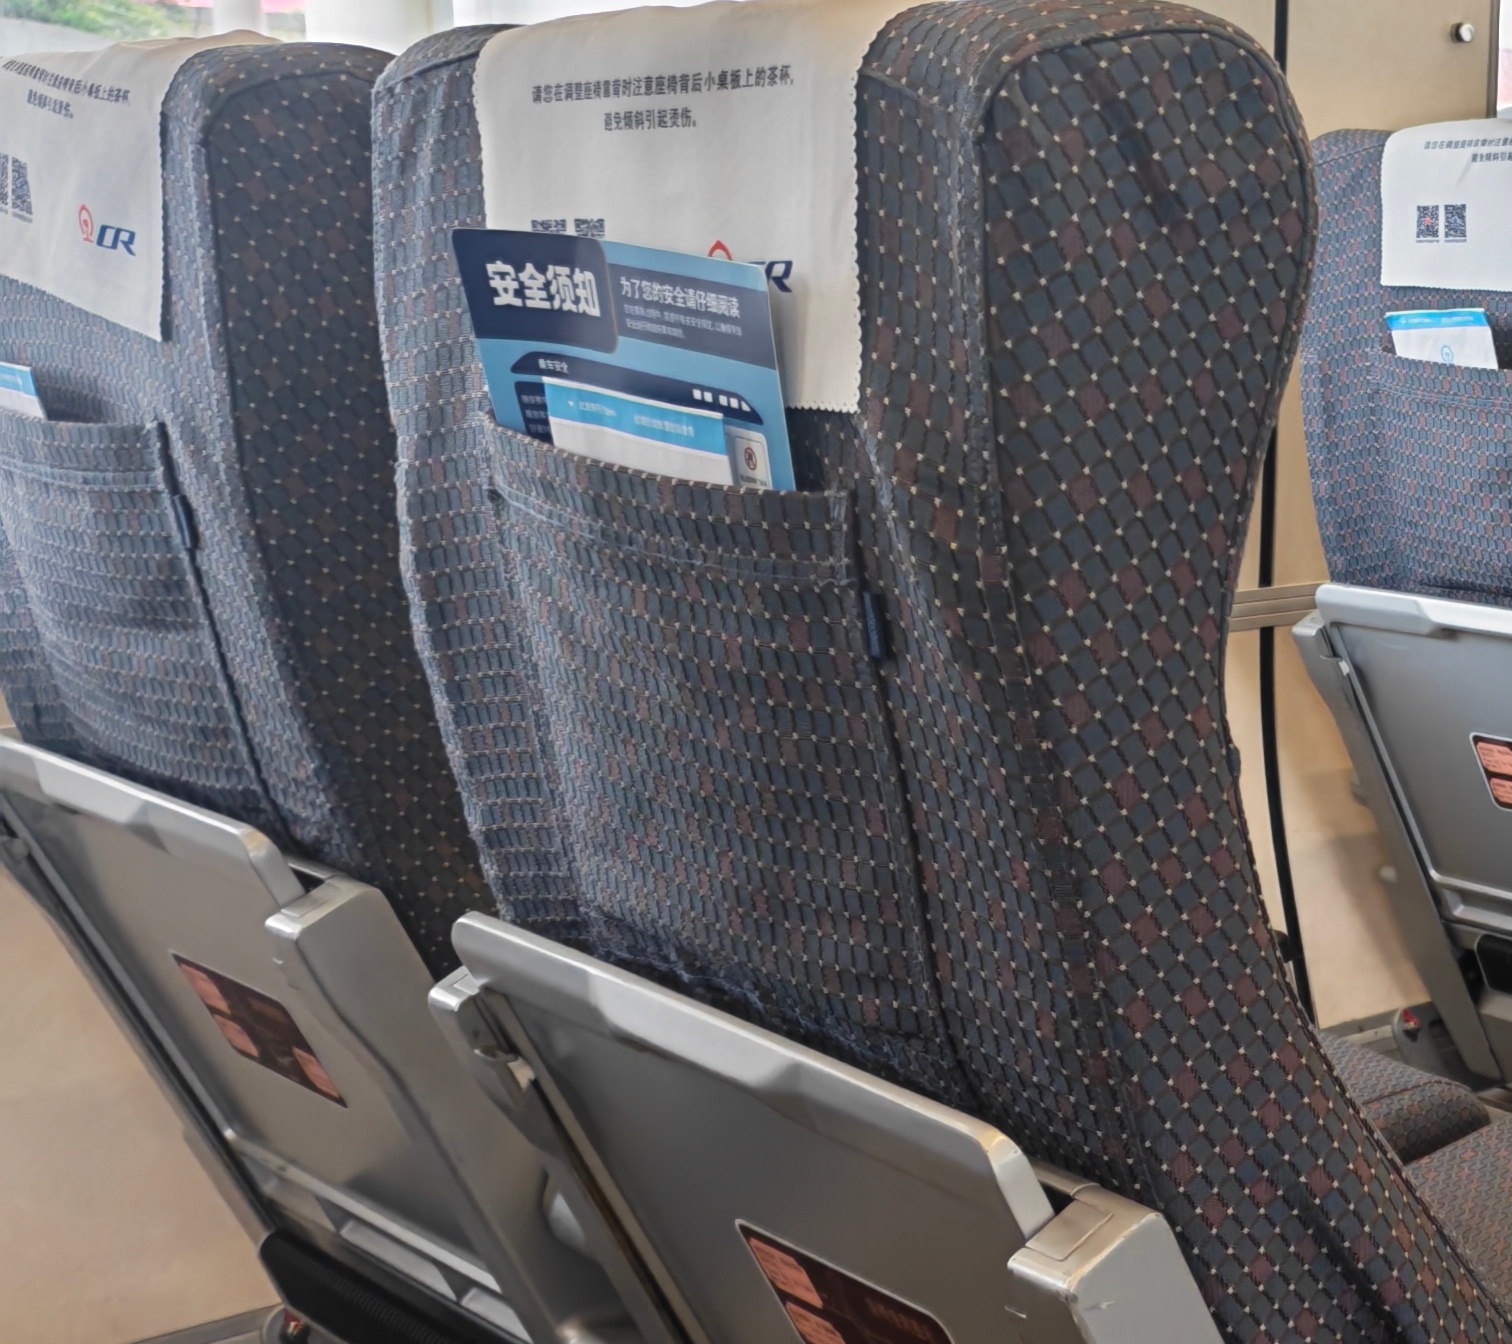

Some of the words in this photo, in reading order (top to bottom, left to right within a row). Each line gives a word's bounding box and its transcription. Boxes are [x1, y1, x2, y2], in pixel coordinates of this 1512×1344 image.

[486, 261, 600, 317] 安全须知
[620, 276, 741, 319] 为了您的安全请仔细阅读
